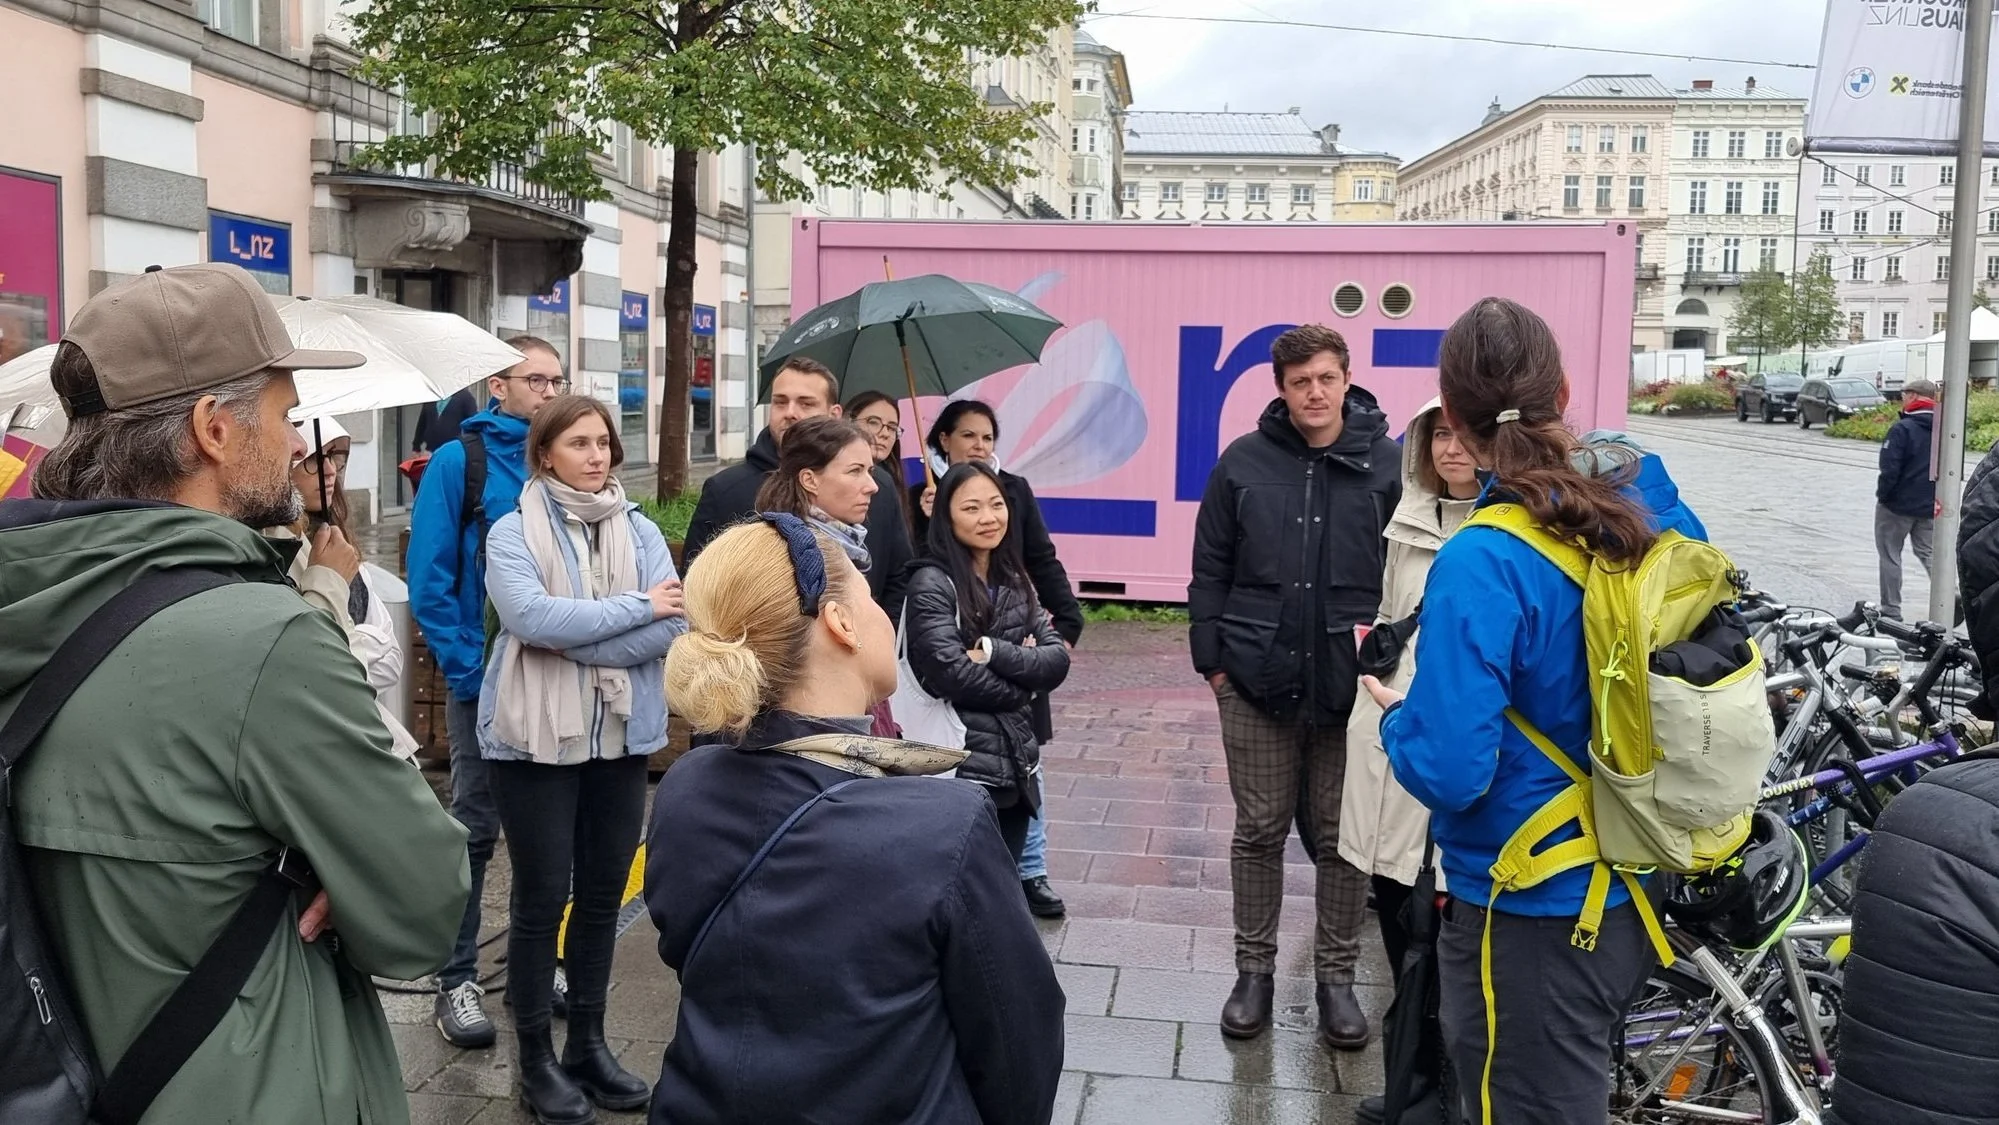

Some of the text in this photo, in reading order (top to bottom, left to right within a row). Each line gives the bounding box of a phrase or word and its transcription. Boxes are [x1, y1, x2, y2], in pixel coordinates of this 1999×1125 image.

[1701, 702, 1709, 712] 18
[1702, 714, 1712, 756] TRAVERSE
[1760, 775, 1816, 799] OUNTRY
